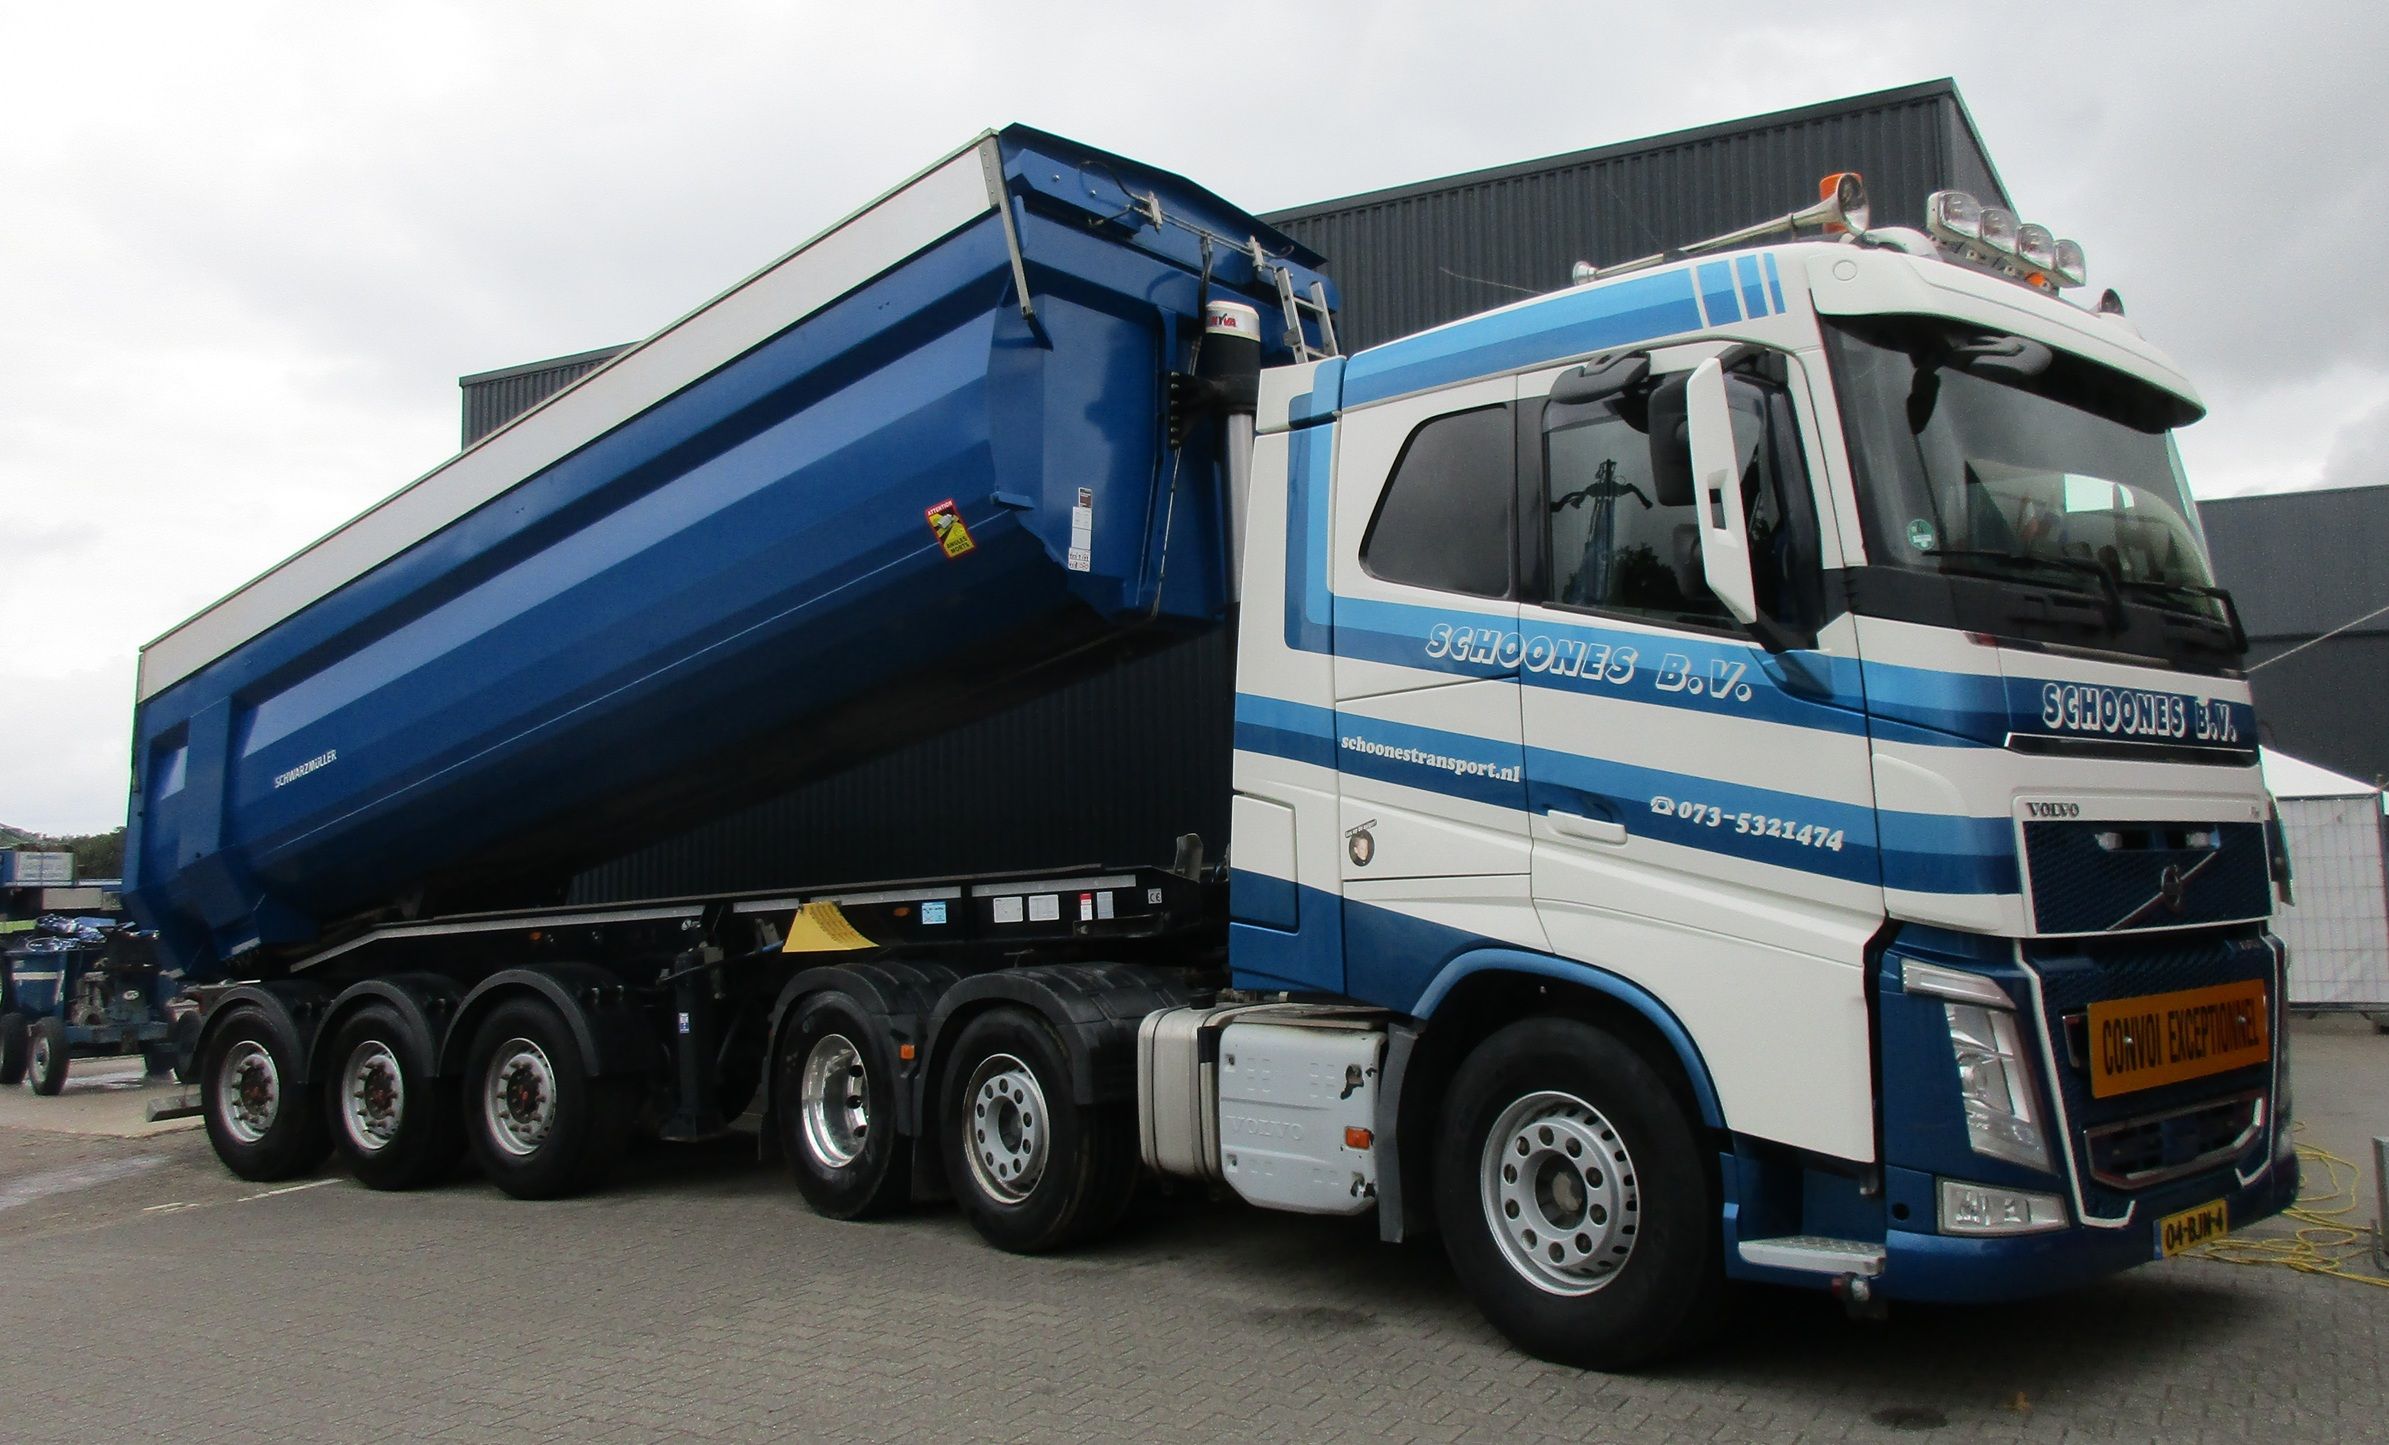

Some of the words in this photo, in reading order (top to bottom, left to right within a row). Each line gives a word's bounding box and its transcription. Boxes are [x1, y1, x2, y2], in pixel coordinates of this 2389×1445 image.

[927, 500, 953, 516] ATTENTION
[946, 536, 968, 550] ANGLES
[950, 542, 970, 554] MORTS
[1425, 622, 1638, 684] SCHOONES
[1655, 652, 1753, 702] B.V.
[2042, 682, 2186, 739] SCHOONES
[2195, 698, 2238, 743] B.V.
[274, 749, 337, 789] SCHWARZMÜLLER
[1341, 734, 1520, 784] schoonestransport.nl
[1679, 800, 1843, 852] 073-5321474
[2026, 801, 2080, 818] VOLVO
[2102, 1013, 2163, 1076] CONVOI
[2167, 998, 2260, 1065] EXCEPTIONNEL
[1225, 1115, 1304, 1141] VOLVO
